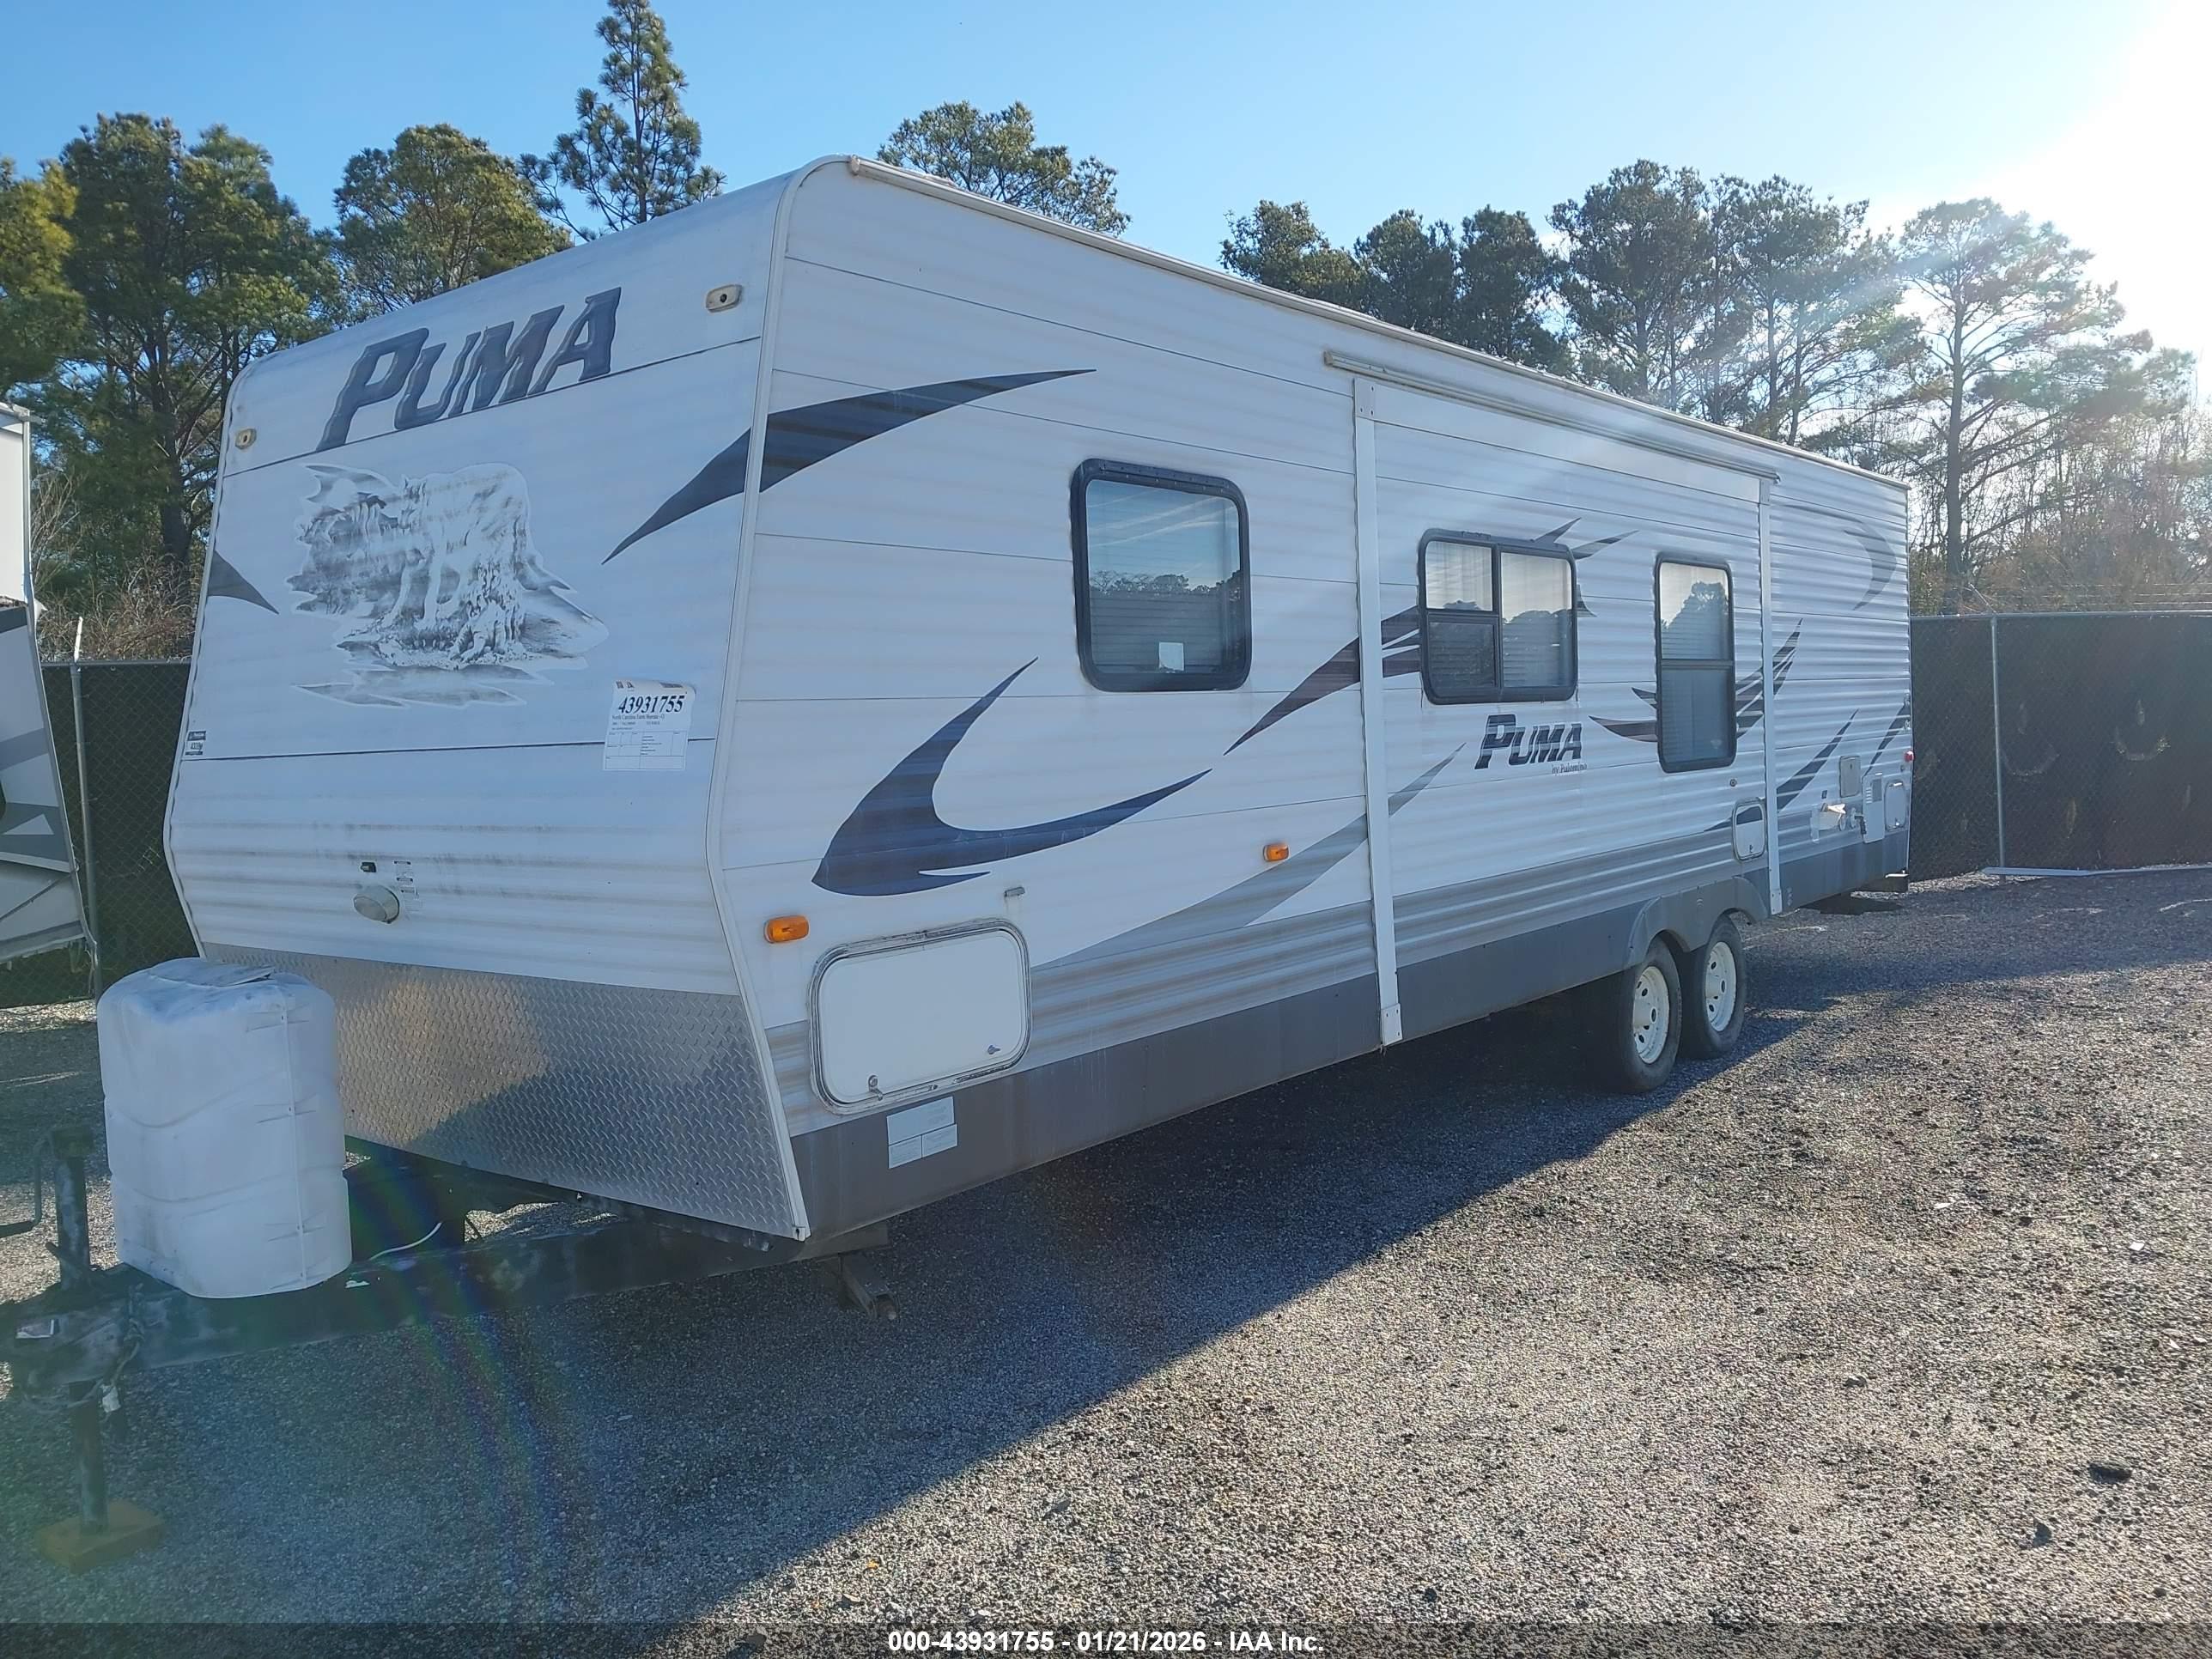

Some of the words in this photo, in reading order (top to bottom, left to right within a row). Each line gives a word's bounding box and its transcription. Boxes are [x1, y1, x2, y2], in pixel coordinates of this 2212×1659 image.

[316, 287, 622, 452] PUMA
[617, 695, 685, 714] 43931755
[1474, 714, 1583, 770] PUMA
